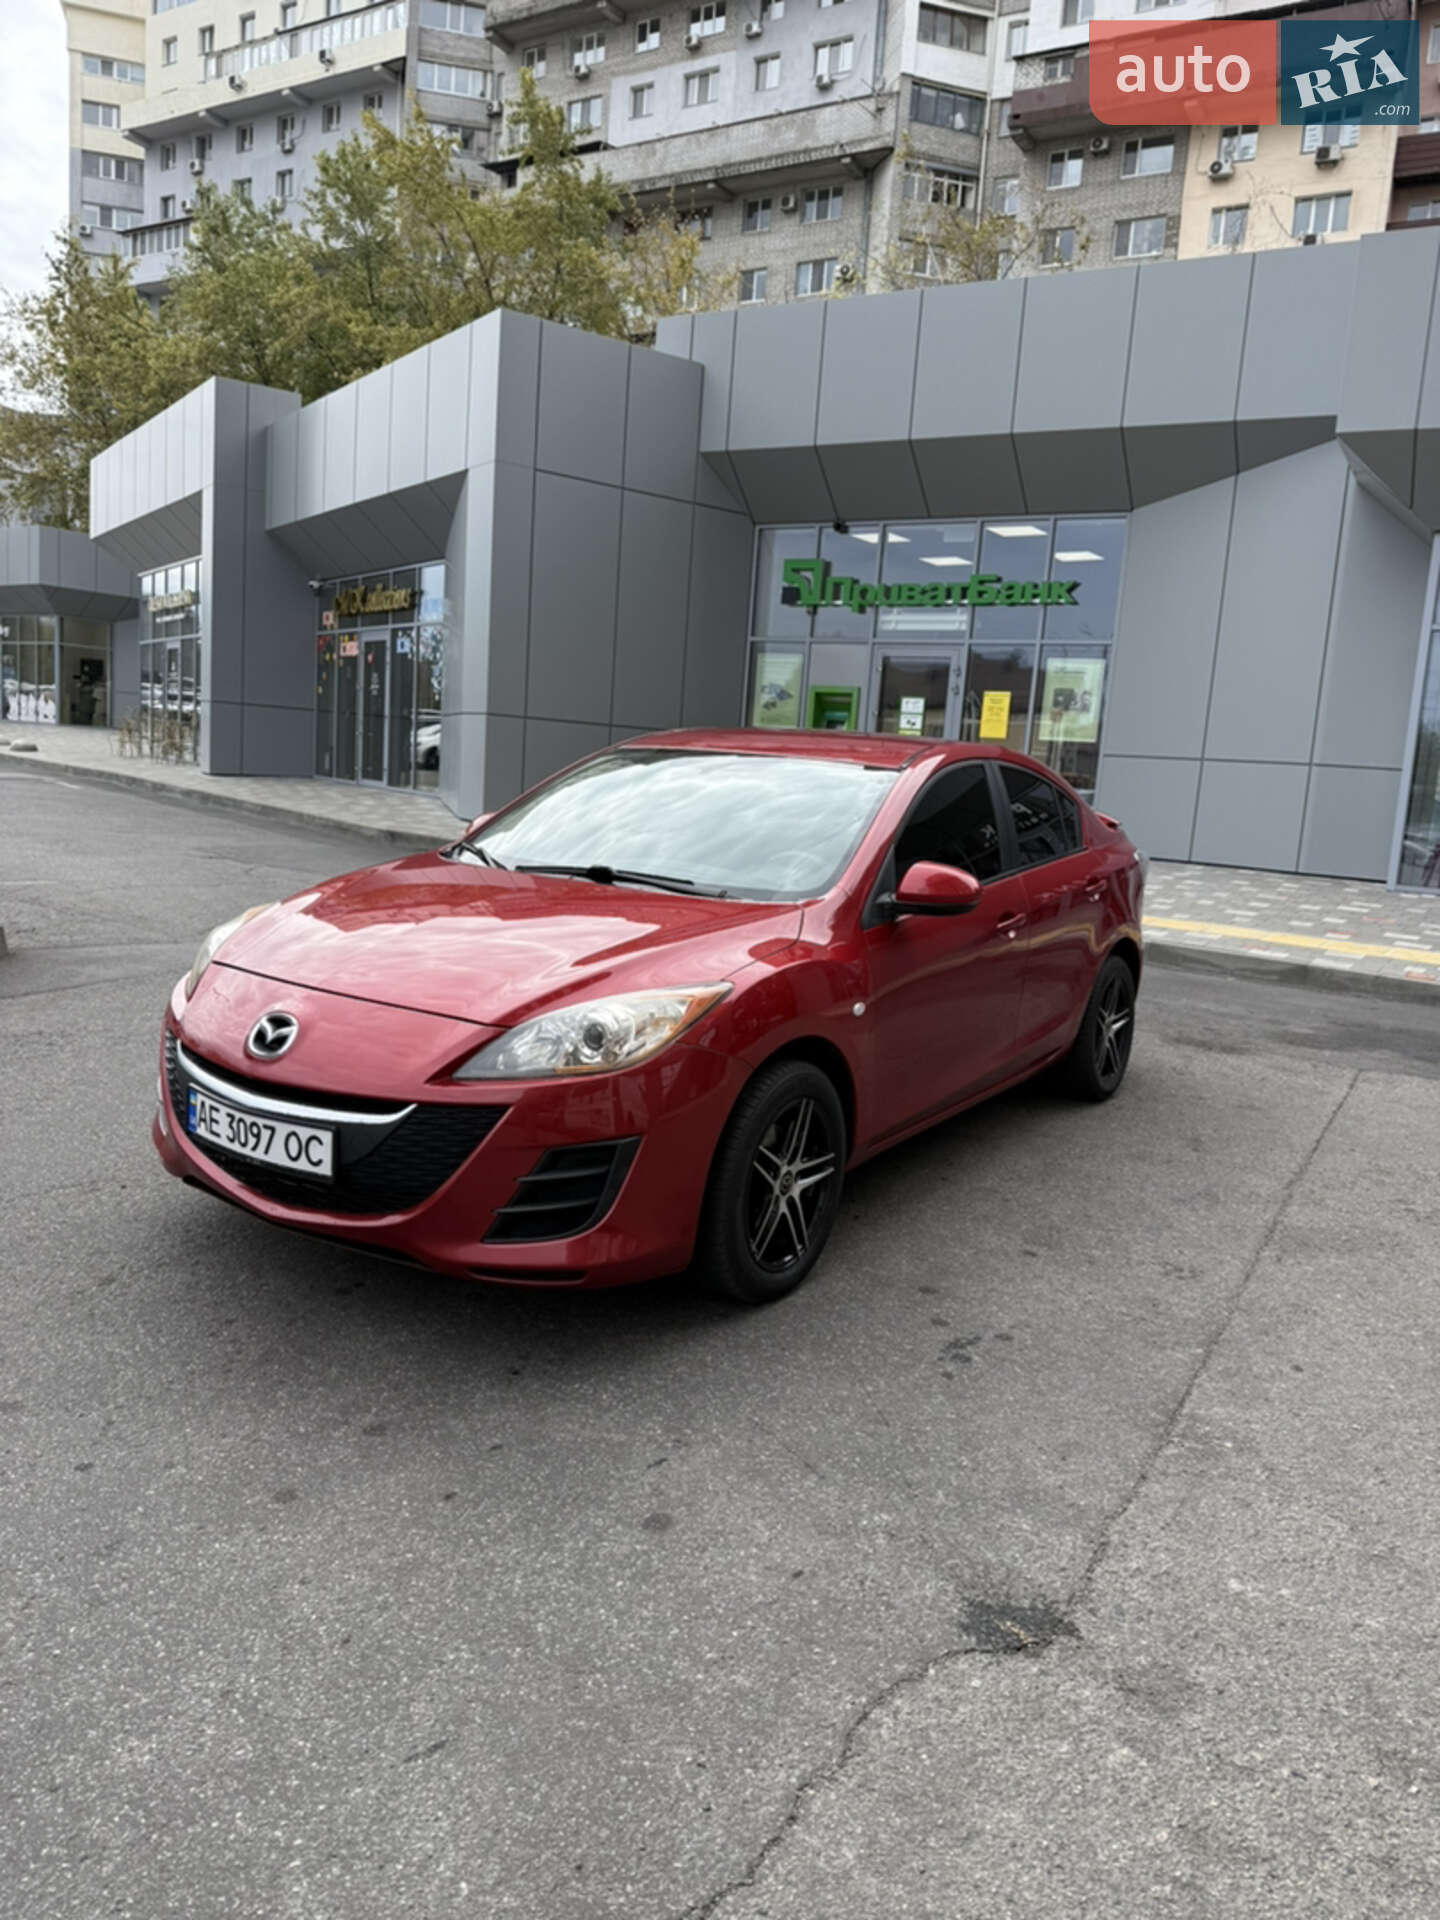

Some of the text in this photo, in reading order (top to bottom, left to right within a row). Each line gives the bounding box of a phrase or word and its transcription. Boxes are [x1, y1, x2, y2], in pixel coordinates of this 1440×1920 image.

[822, 574, 1077, 613] ПриватБанк
[198, 1100, 221, 1138] AE
[226, 1112, 276, 1155] 3097
[284, 1130, 323, 1167] OC
